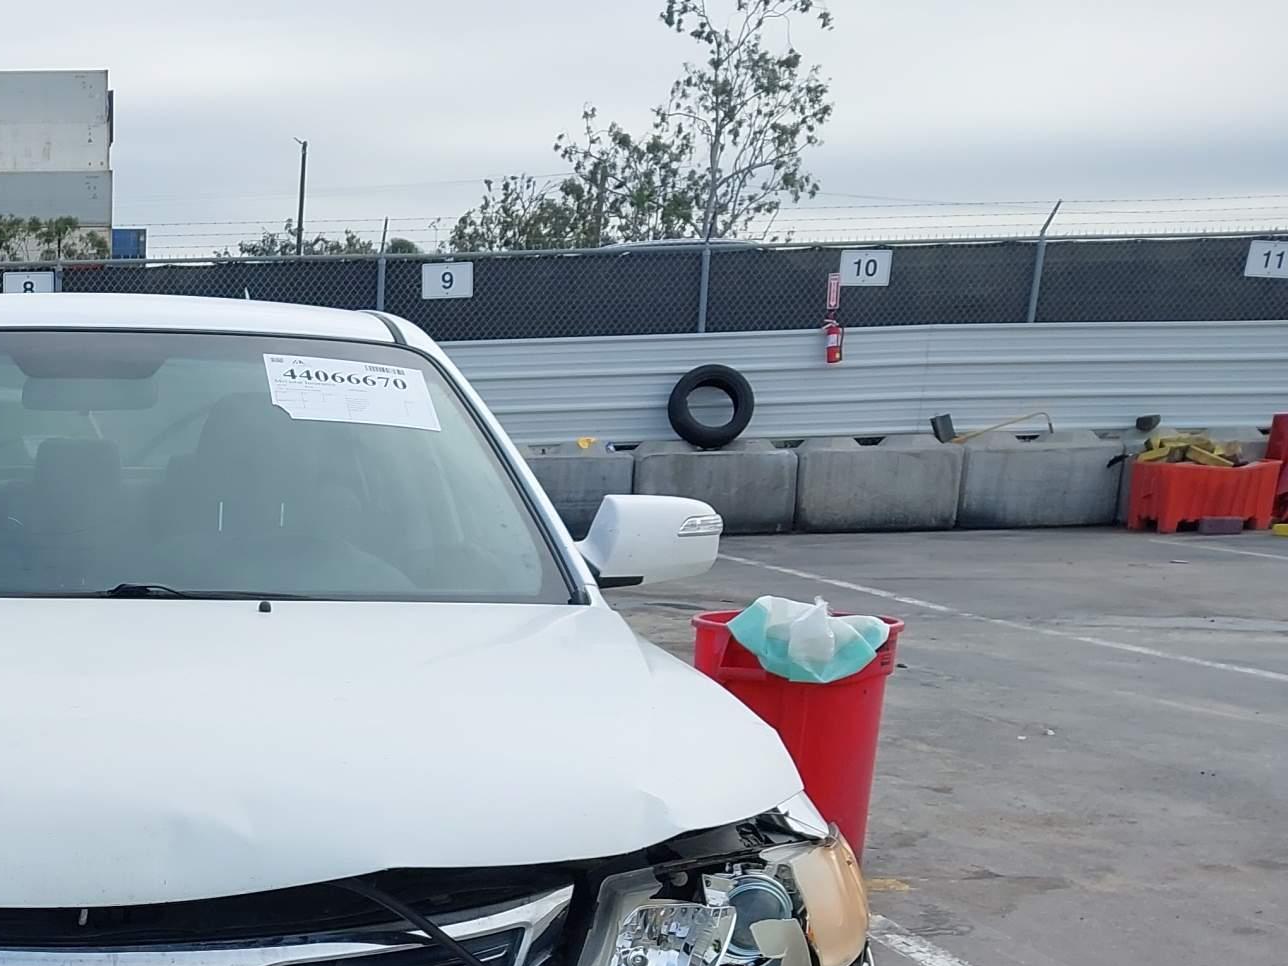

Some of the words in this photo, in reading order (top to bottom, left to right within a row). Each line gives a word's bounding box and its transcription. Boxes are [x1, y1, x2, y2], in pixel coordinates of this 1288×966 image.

[853, 258, 878, 277] 10
[1263, 250, 1285, 269] 11
[441, 271, 454, 289] 9
[283, 367, 408, 391] 44066670
